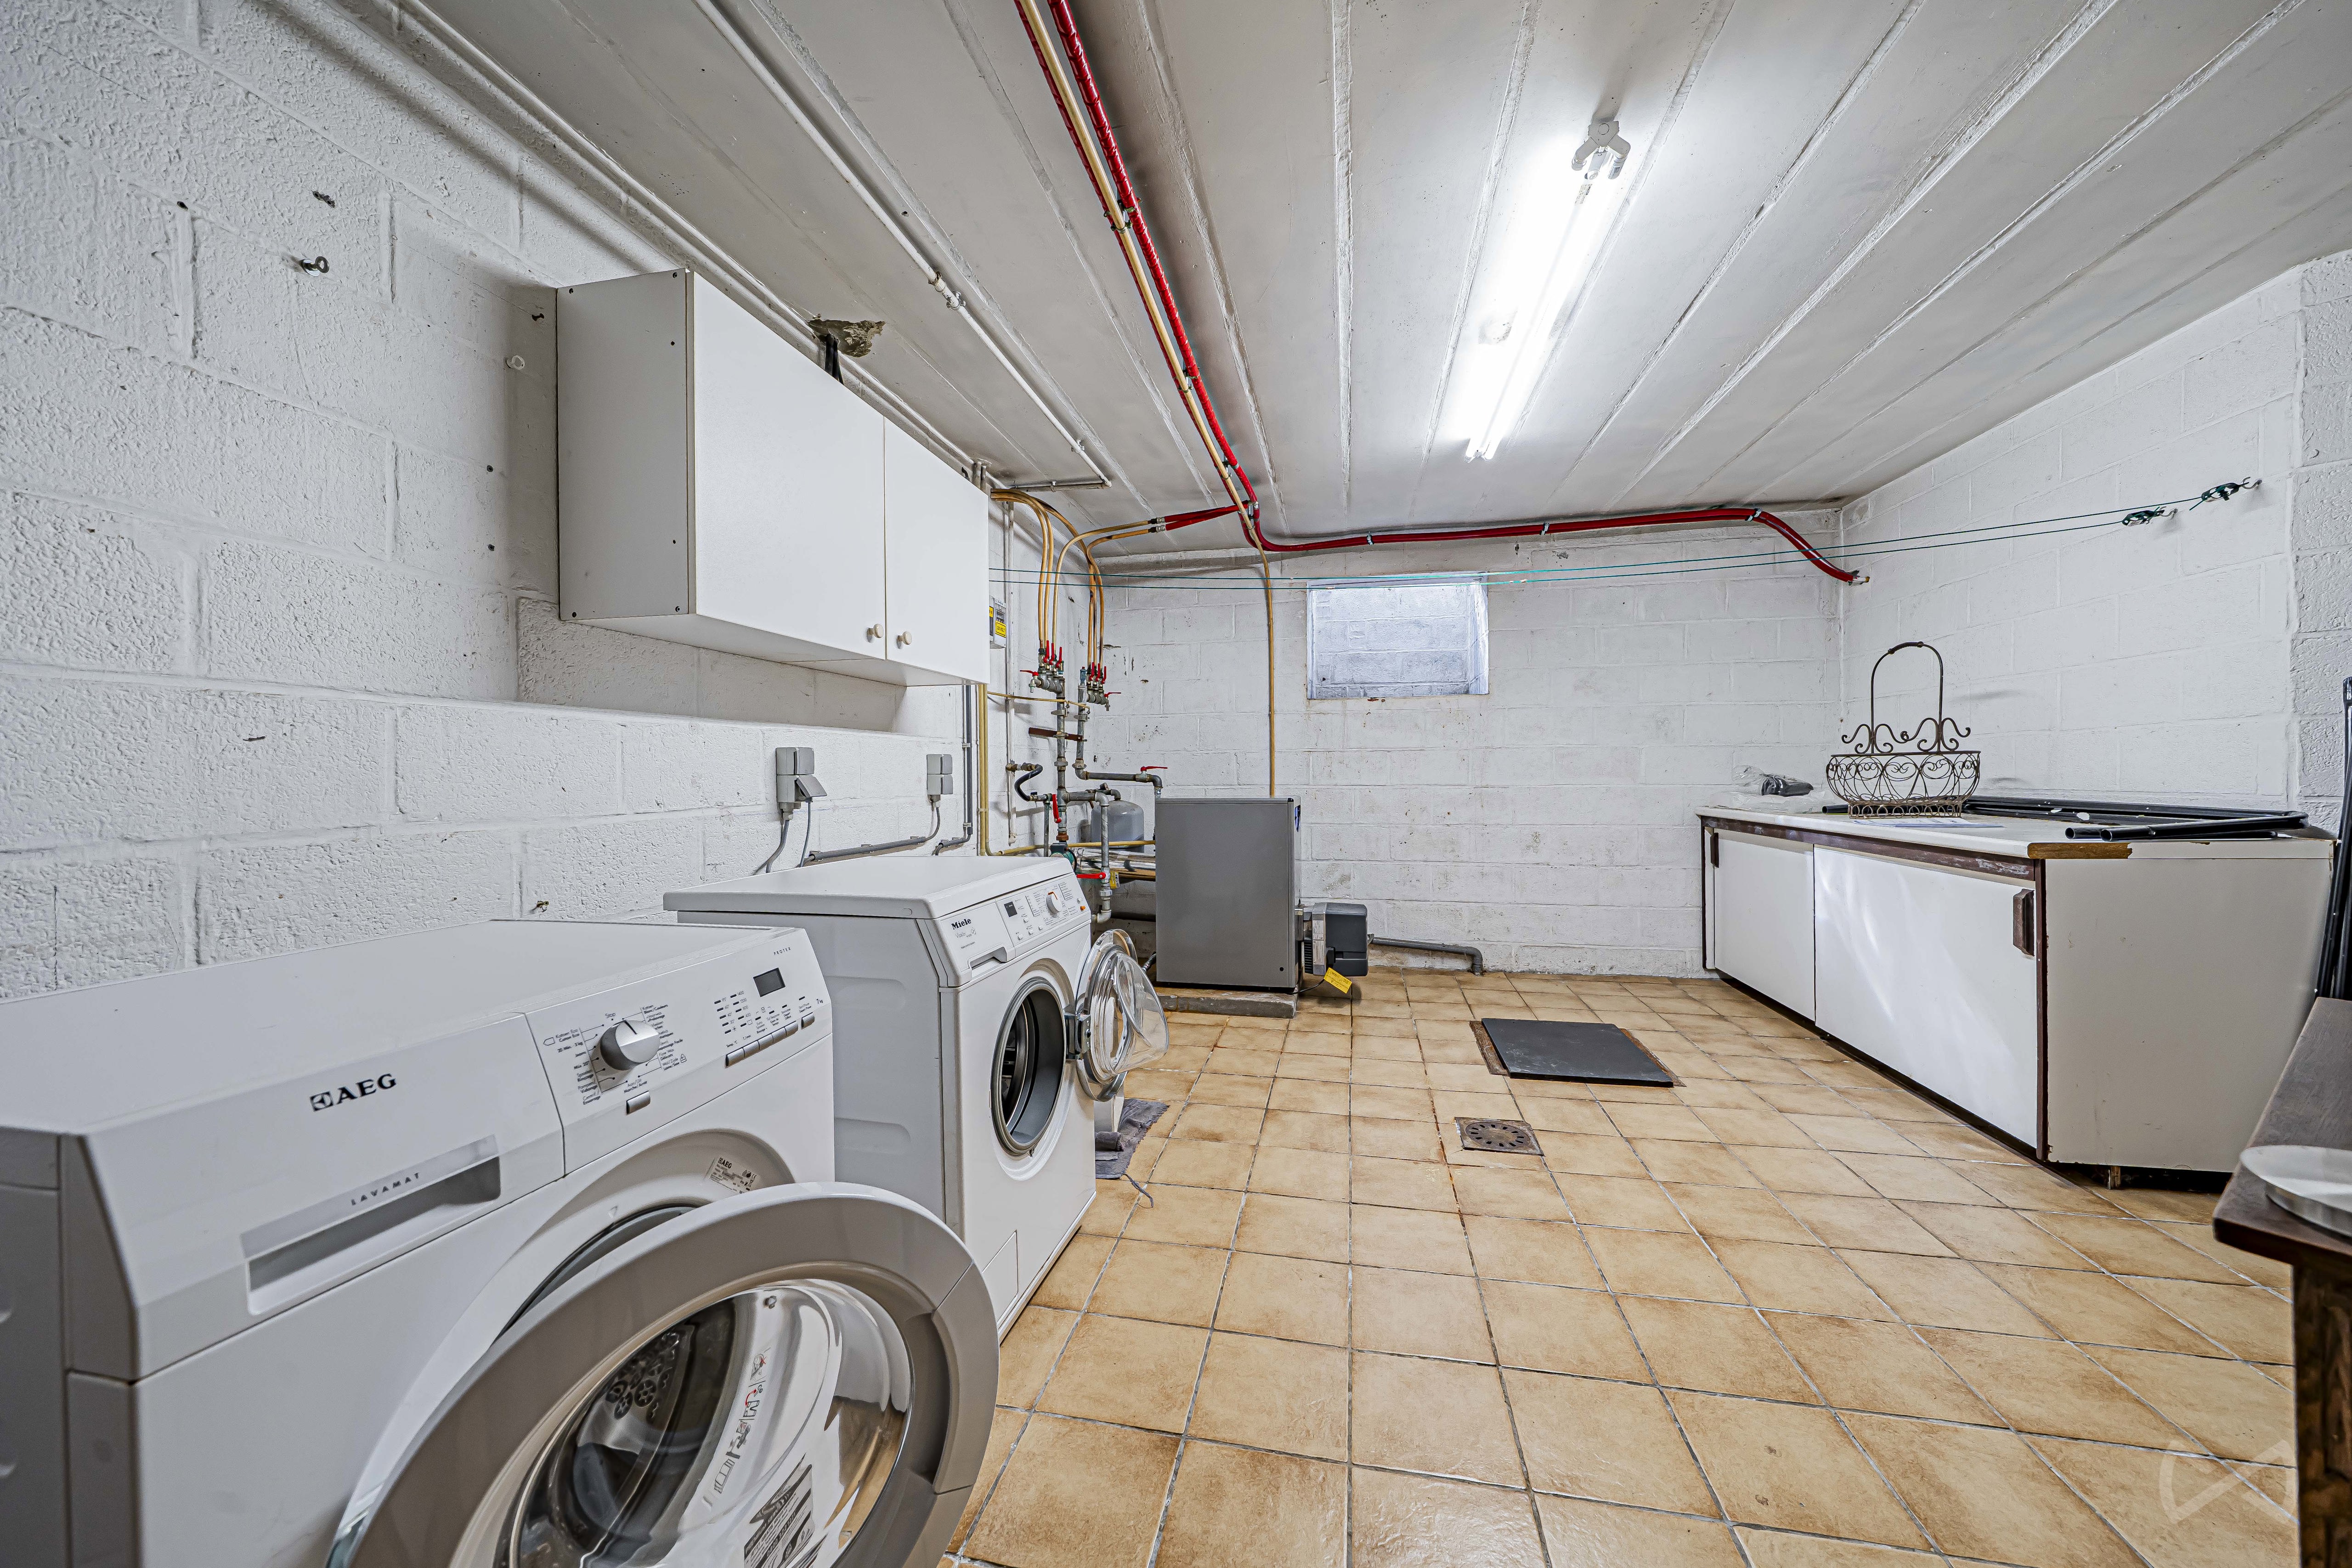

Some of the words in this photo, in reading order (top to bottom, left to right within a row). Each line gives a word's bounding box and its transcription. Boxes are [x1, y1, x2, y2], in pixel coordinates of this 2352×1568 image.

[951, 919, 972, 930] Miele
[773, 947, 791, 955] PROTEX
[337, 1073, 397, 1105] AEG
[351, 1172, 419, 1206] LAVAMAT
